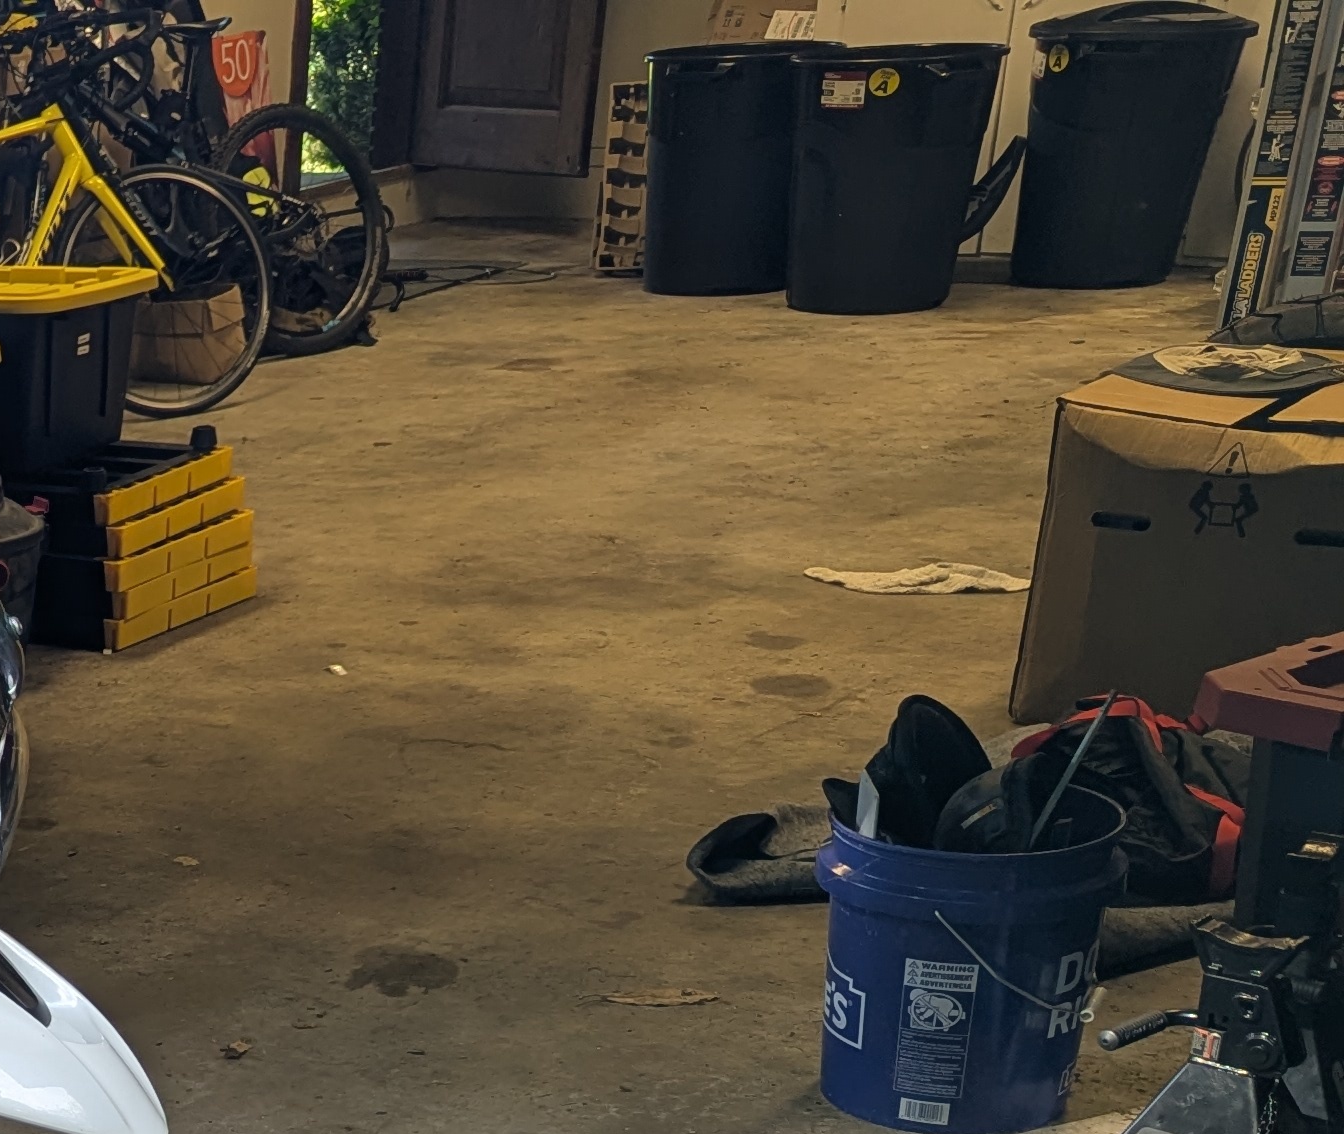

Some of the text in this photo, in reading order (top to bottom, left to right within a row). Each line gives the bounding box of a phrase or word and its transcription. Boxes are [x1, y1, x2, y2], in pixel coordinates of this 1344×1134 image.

[873, 80, 888, 94] A
[1237, 233, 1264, 299] LADDERS
[921, 962, 975, 973] WARNING
[919, 979, 972, 990] ADVERTENCIA
